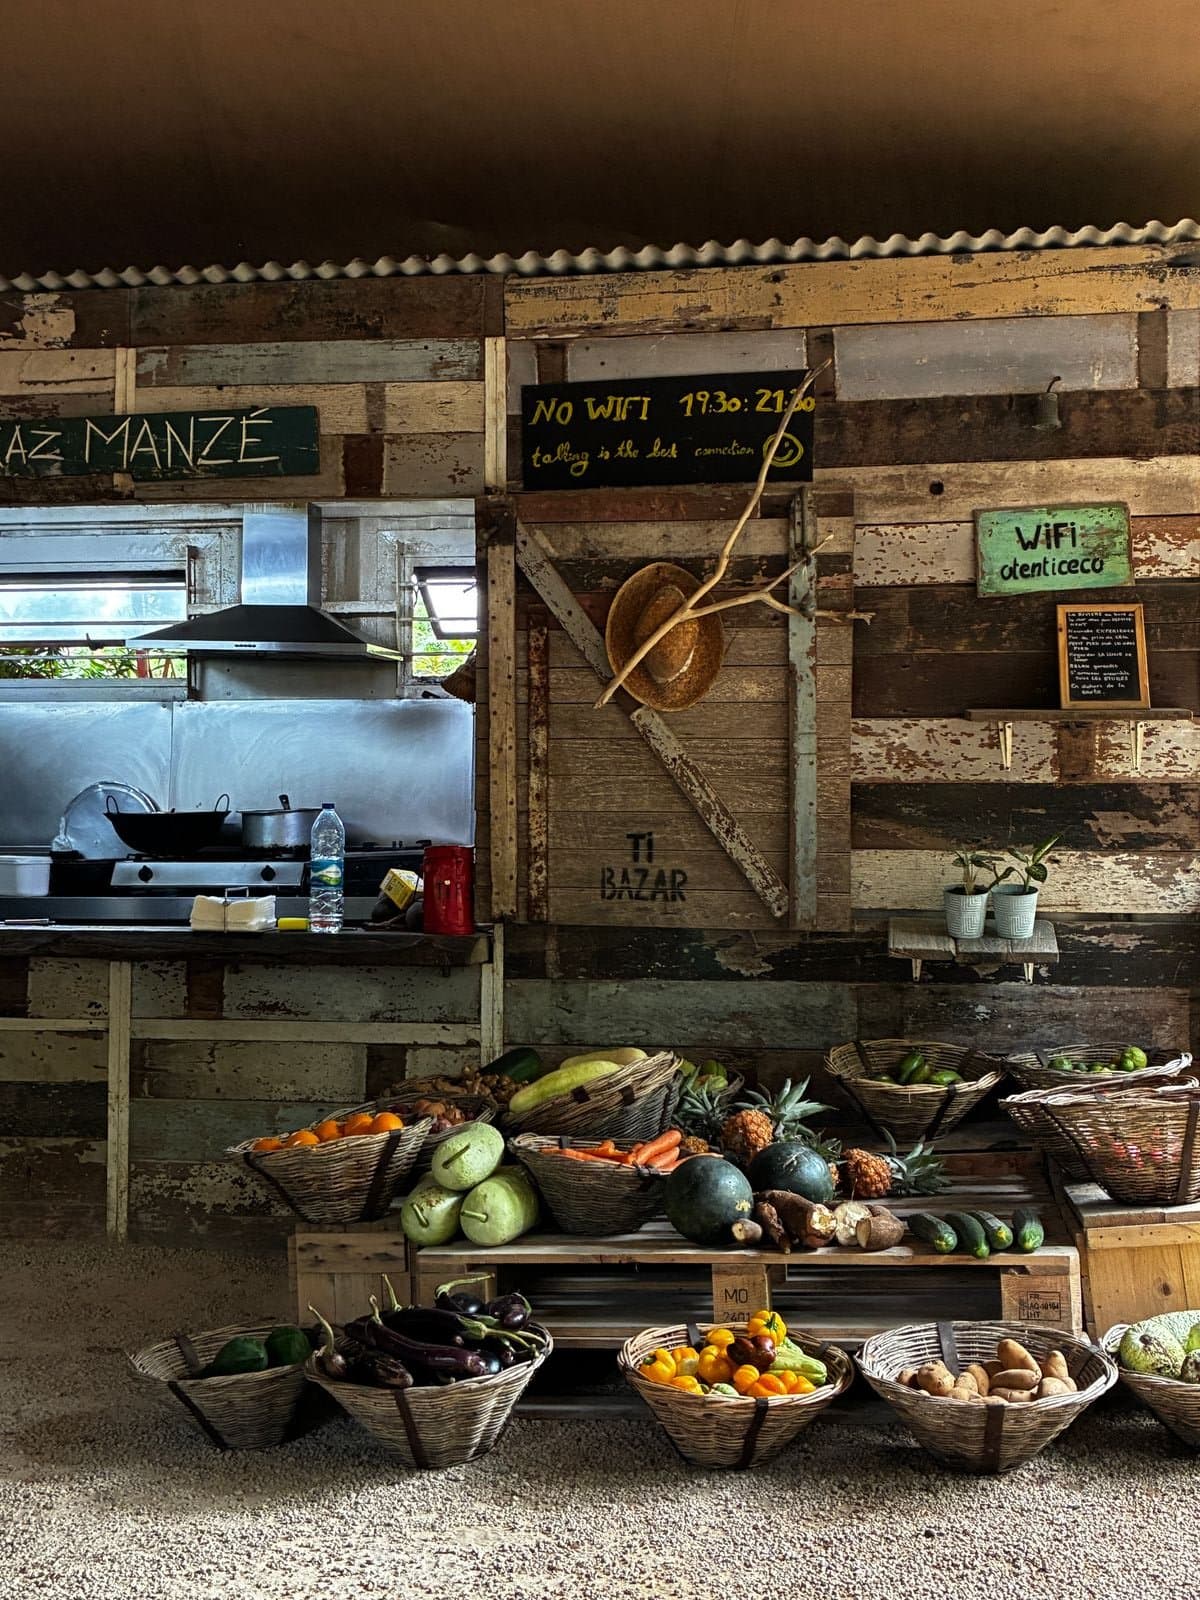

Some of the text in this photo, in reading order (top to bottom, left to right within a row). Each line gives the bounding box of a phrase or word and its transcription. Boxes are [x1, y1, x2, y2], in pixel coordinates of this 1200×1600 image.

[528, 398, 573, 425] NO
[584, 395, 651, 421] WIFI
[0, 408, 280, 469] AZ MANZÉ
[532, 437, 754, 477] talking is the best connection
[1015, 521, 1077, 551] WiFi
[600, 866, 688, 902] BAZAR
[724, 1287, 749, 1304] MO
